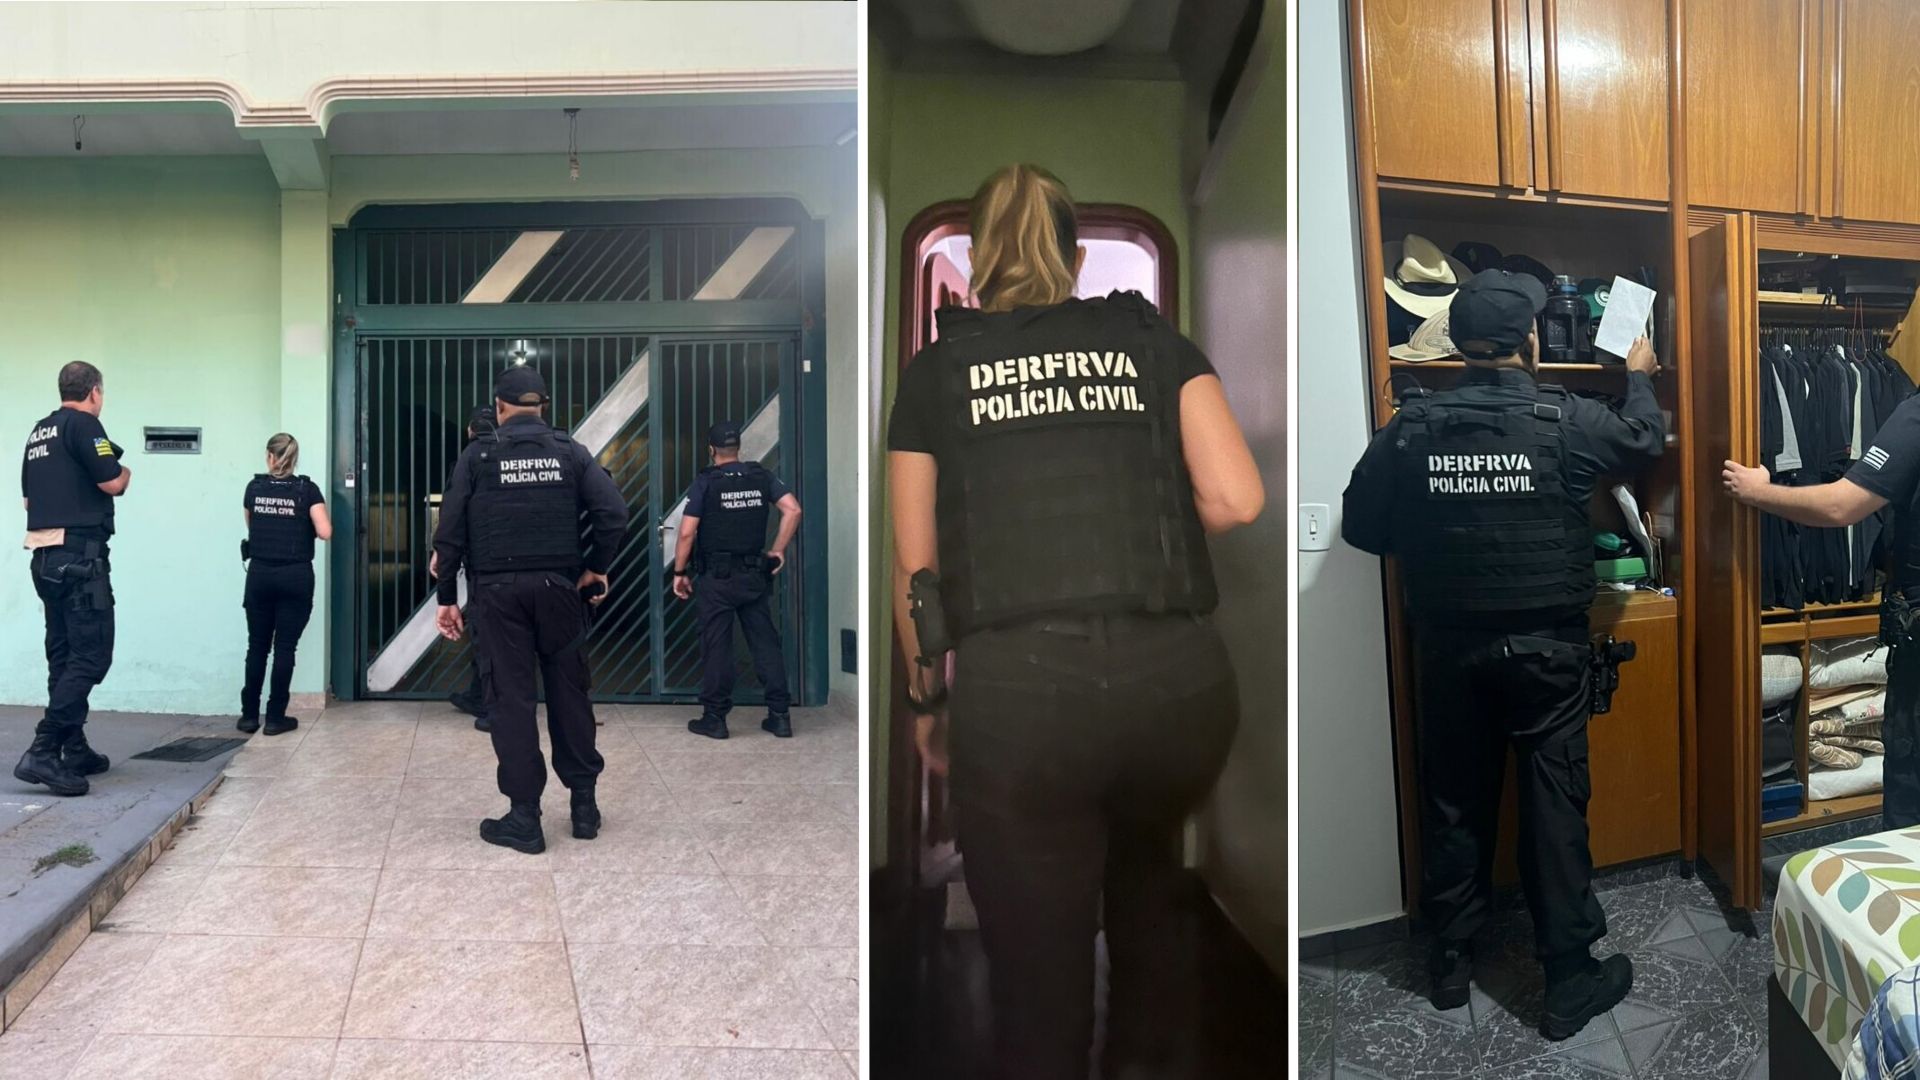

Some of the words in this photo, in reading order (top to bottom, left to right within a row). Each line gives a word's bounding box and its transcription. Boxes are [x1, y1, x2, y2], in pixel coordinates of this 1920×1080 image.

[969, 351, 1138, 390] DERFRVA
[971, 383, 1075, 426] POLÍCIA
[1079, 385, 1145, 412] CIVIL
[28, 444, 50, 461] CIVIL
[500, 458, 561, 471] DERFRVA
[1428, 454, 1532, 471] DERFRVA
[500, 468, 537, 484] POLÍCIA
[538, 470, 563, 481] CIVIL
[1429, 472, 1490, 493] POLÍCIA
[1493, 475, 1535, 492] CIVIL
[255, 496, 295, 507] DERFRVA
[721, 489, 762, 500] DERFRVA
[254, 503, 277, 514] POLÍCIA
[278, 506, 295, 516] CIVIL
[747, 499, 763, 507] CIVIL
